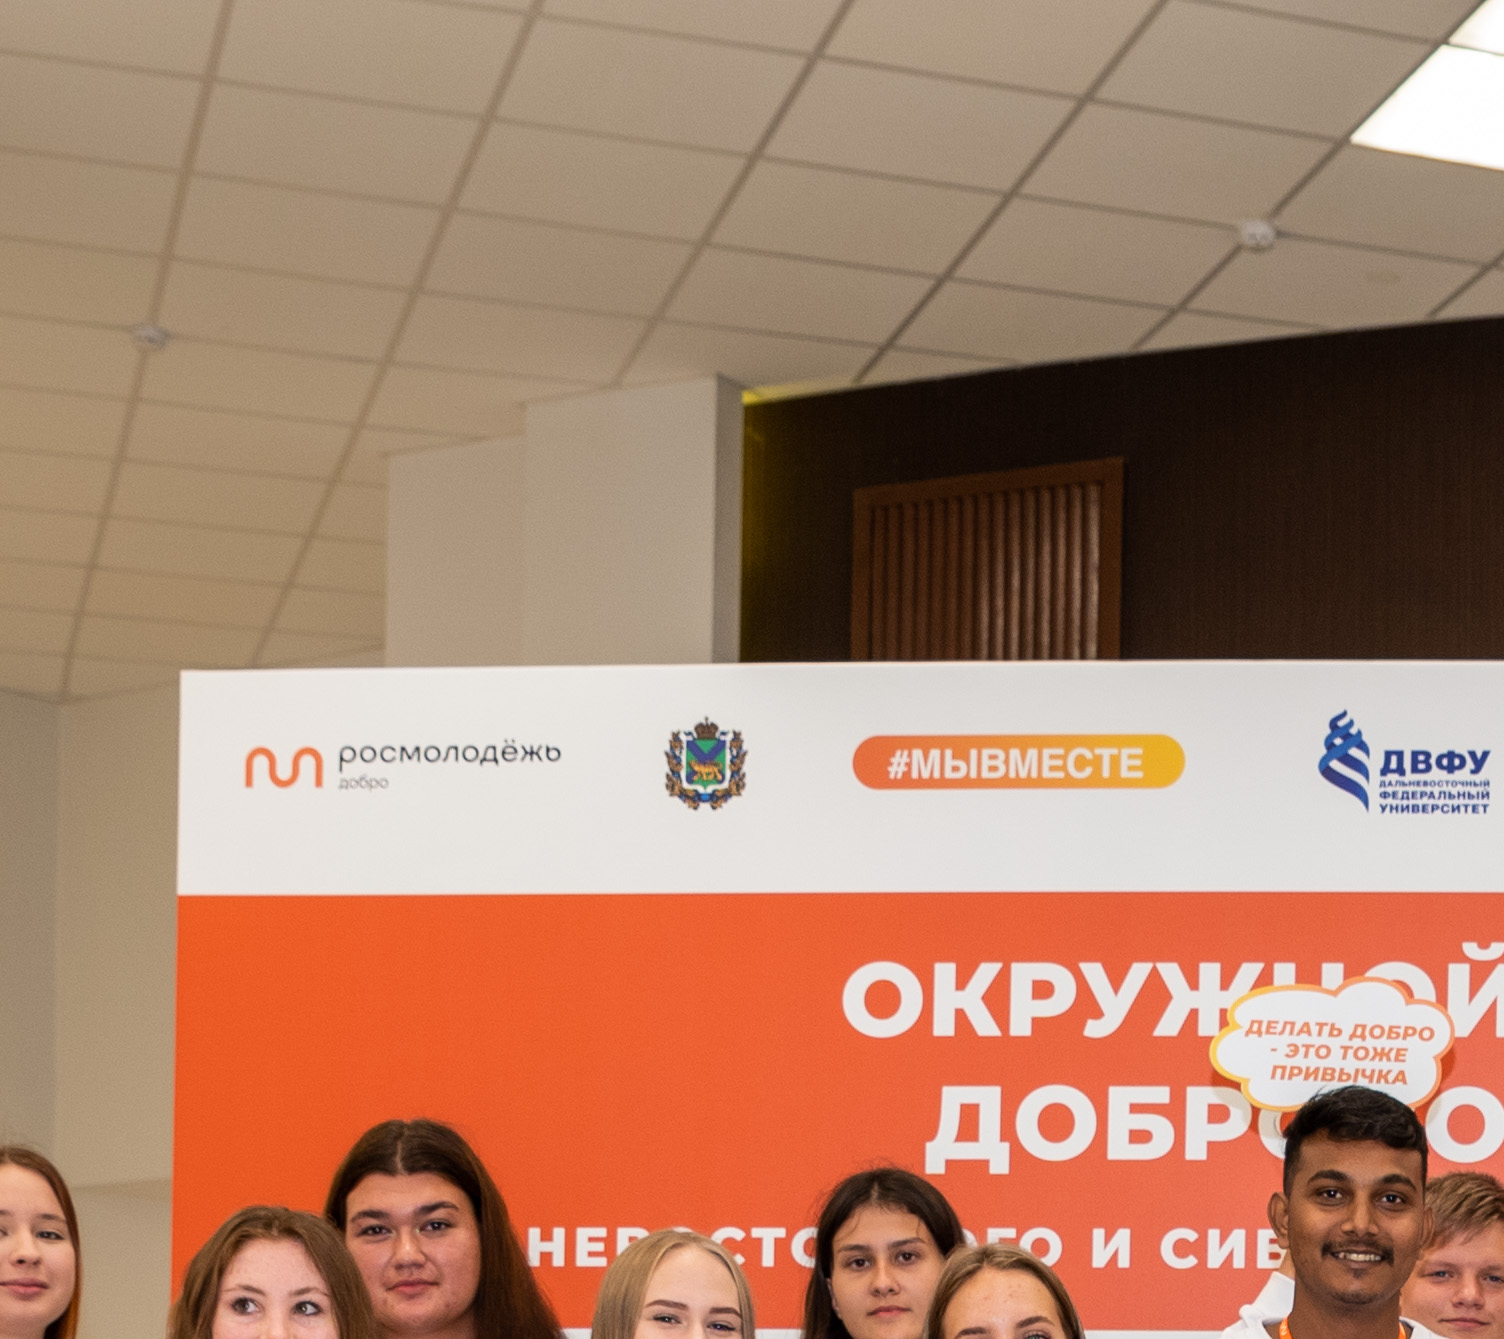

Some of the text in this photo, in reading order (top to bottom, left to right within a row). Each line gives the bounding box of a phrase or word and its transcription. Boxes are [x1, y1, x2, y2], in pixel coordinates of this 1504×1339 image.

[338, 739, 562, 773] росмолодёжь
[887, 746, 1144, 781] #МЫВМЕСТЕ
[1380, 749, 1492, 777] ДВФУ
[338, 775, 390, 791] добро
[1379, 777, 1491, 788] ДАЛЬНЕВОСТОЧНЫЙ
[1379, 788, 1491, 801] ФЕДЕРАЛЬНЫЙ
[1379, 803, 1490, 815] УНИВЕРСИТЕТ
[1244, 1018, 1437, 1043] ДЕЛАТЬ ДОБРО
[1285, 1042, 1333, 1062] ЭТО
[1339, 1045, 1409, 1063] ТОЖЕ
[1269, 1063, 1409, 1086] ПРИВЫЧКА
[1091, 1227, 1133, 1270] И
